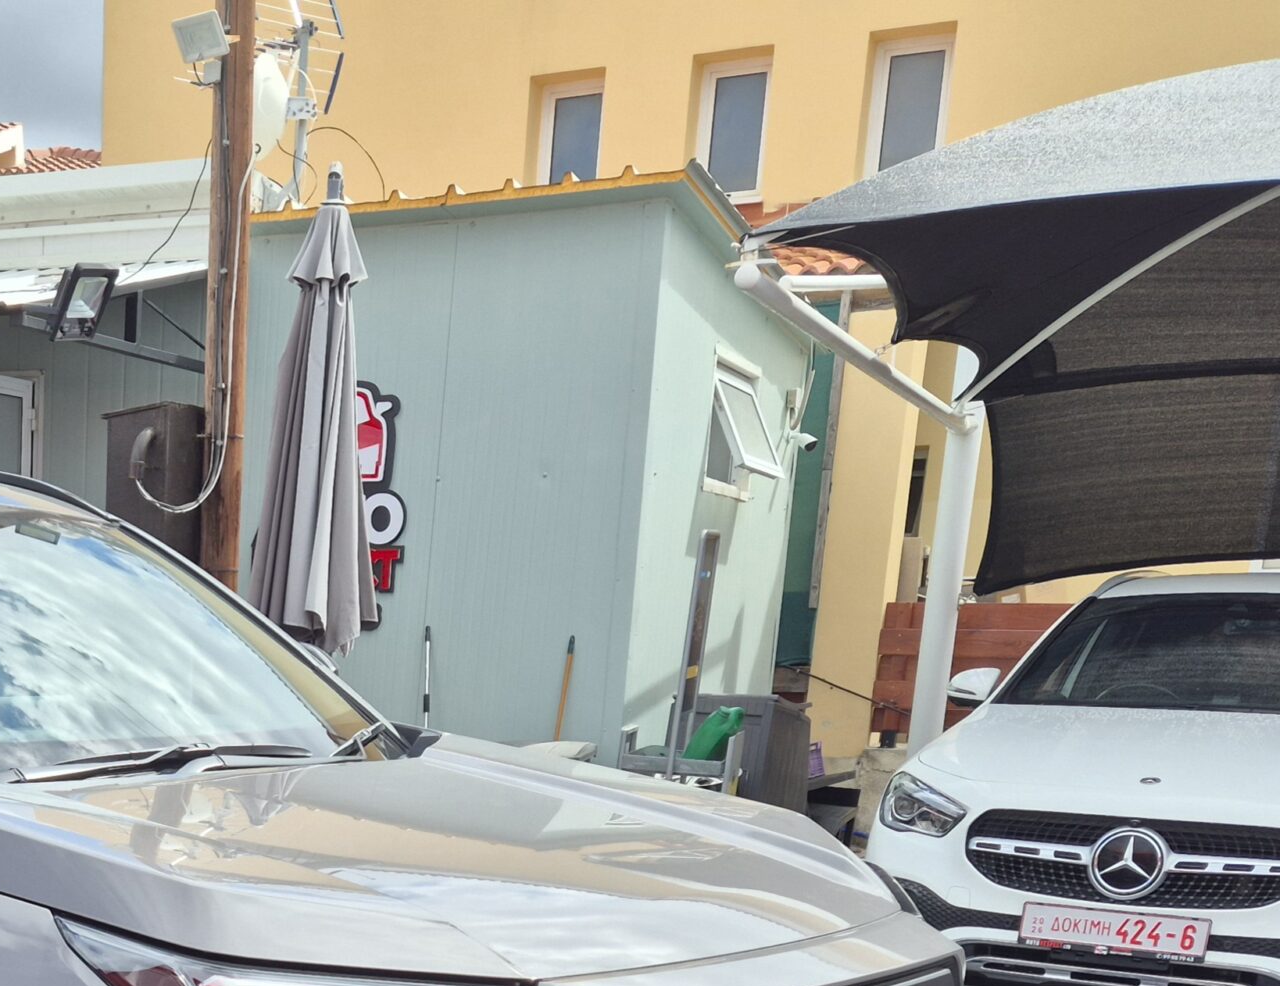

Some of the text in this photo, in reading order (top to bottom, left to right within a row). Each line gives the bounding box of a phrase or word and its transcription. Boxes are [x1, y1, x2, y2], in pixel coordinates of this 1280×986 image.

[1031, 916, 1045, 925] 20
[1031, 925, 1043, 934] 26
[1050, 916, 1198, 951] ΔΟΚΙΜΗ 424-6
